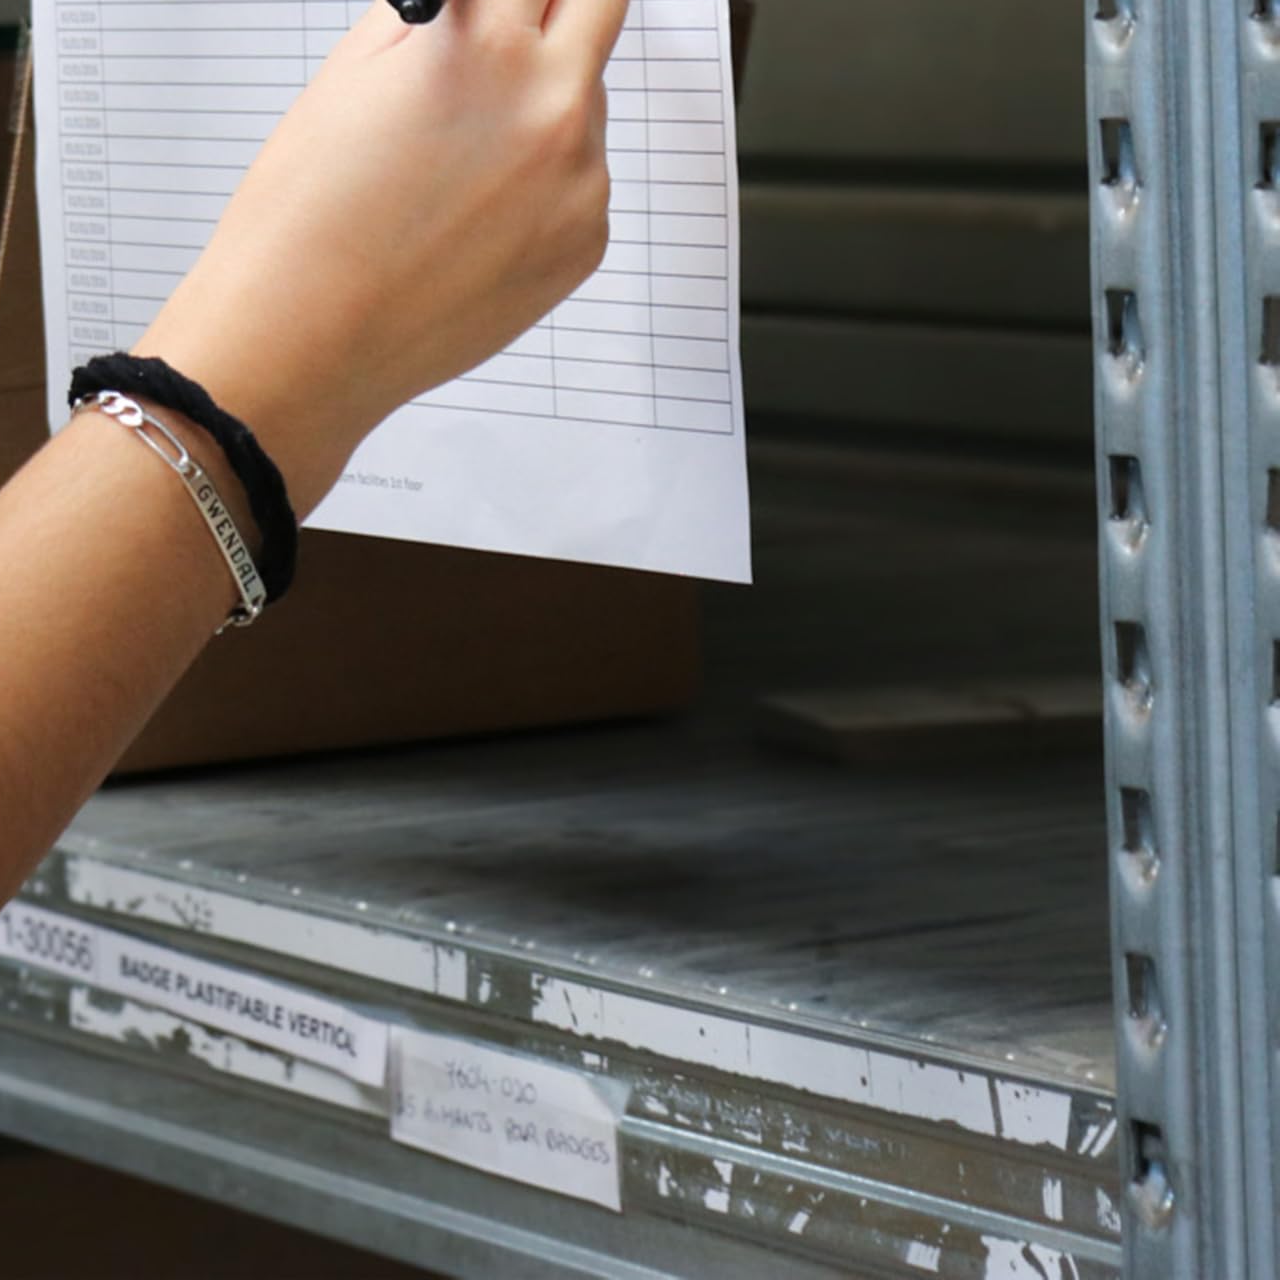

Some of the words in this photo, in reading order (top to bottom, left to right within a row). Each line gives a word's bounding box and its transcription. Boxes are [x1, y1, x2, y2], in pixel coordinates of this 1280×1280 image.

[197, 483, 259, 593] GWENDAL
[120, 954, 172, 992] BADGE
[176, 972, 284, 1030] PLASTIFIABLE
